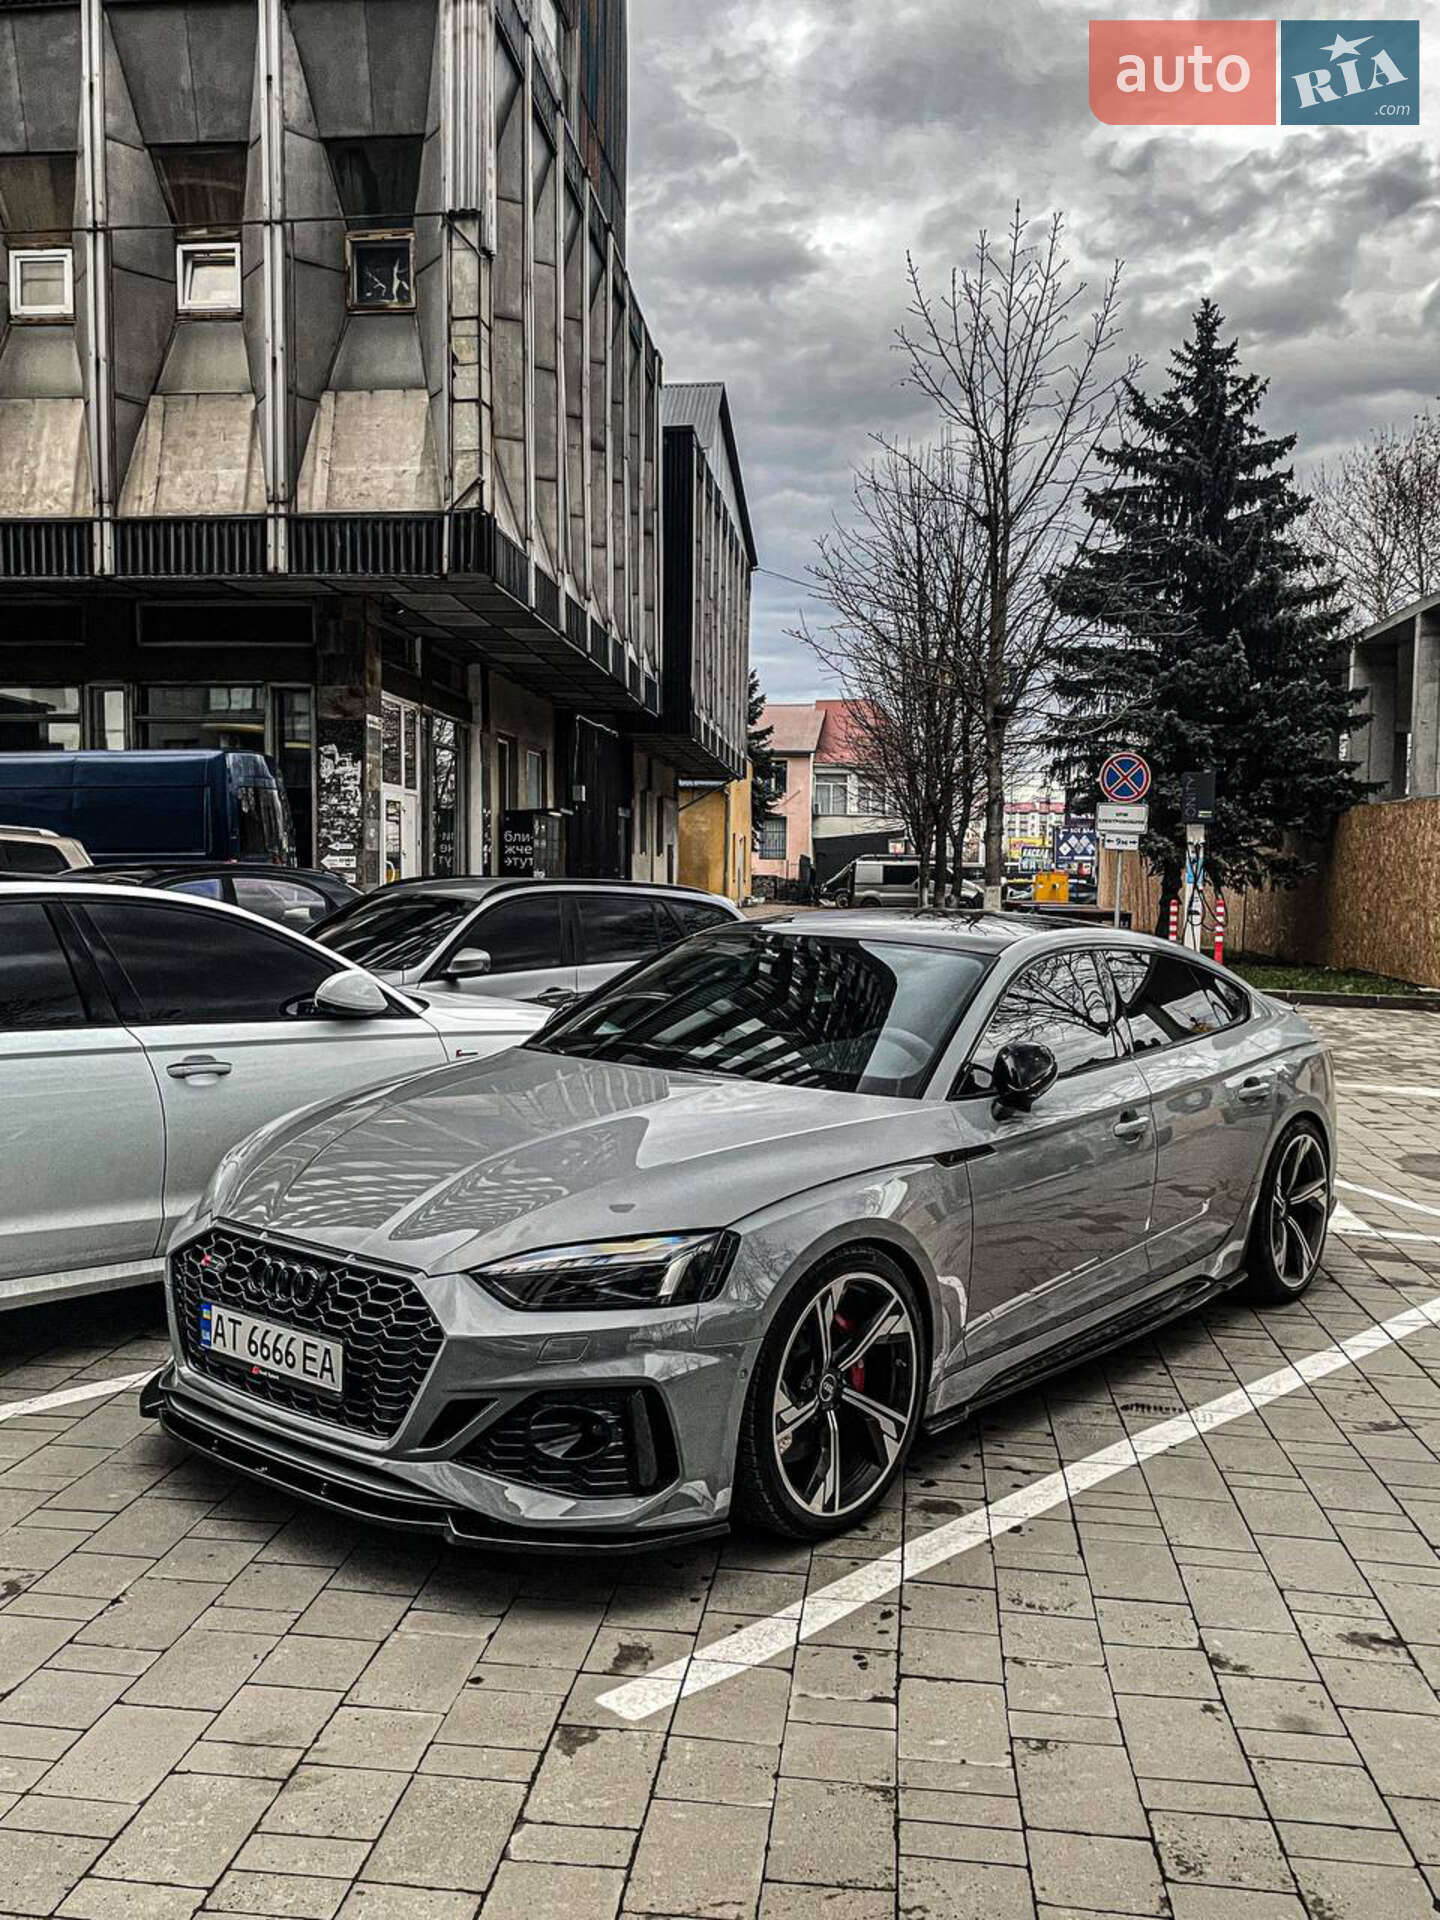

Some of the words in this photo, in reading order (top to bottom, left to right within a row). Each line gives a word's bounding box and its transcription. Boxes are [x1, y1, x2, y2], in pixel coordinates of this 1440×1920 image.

[504, 845, 533, 855] жче
[213, 1313, 243, 1352] AT
[247, 1325, 297, 1369] 6666
[302, 1340, 336, 1384] EA
